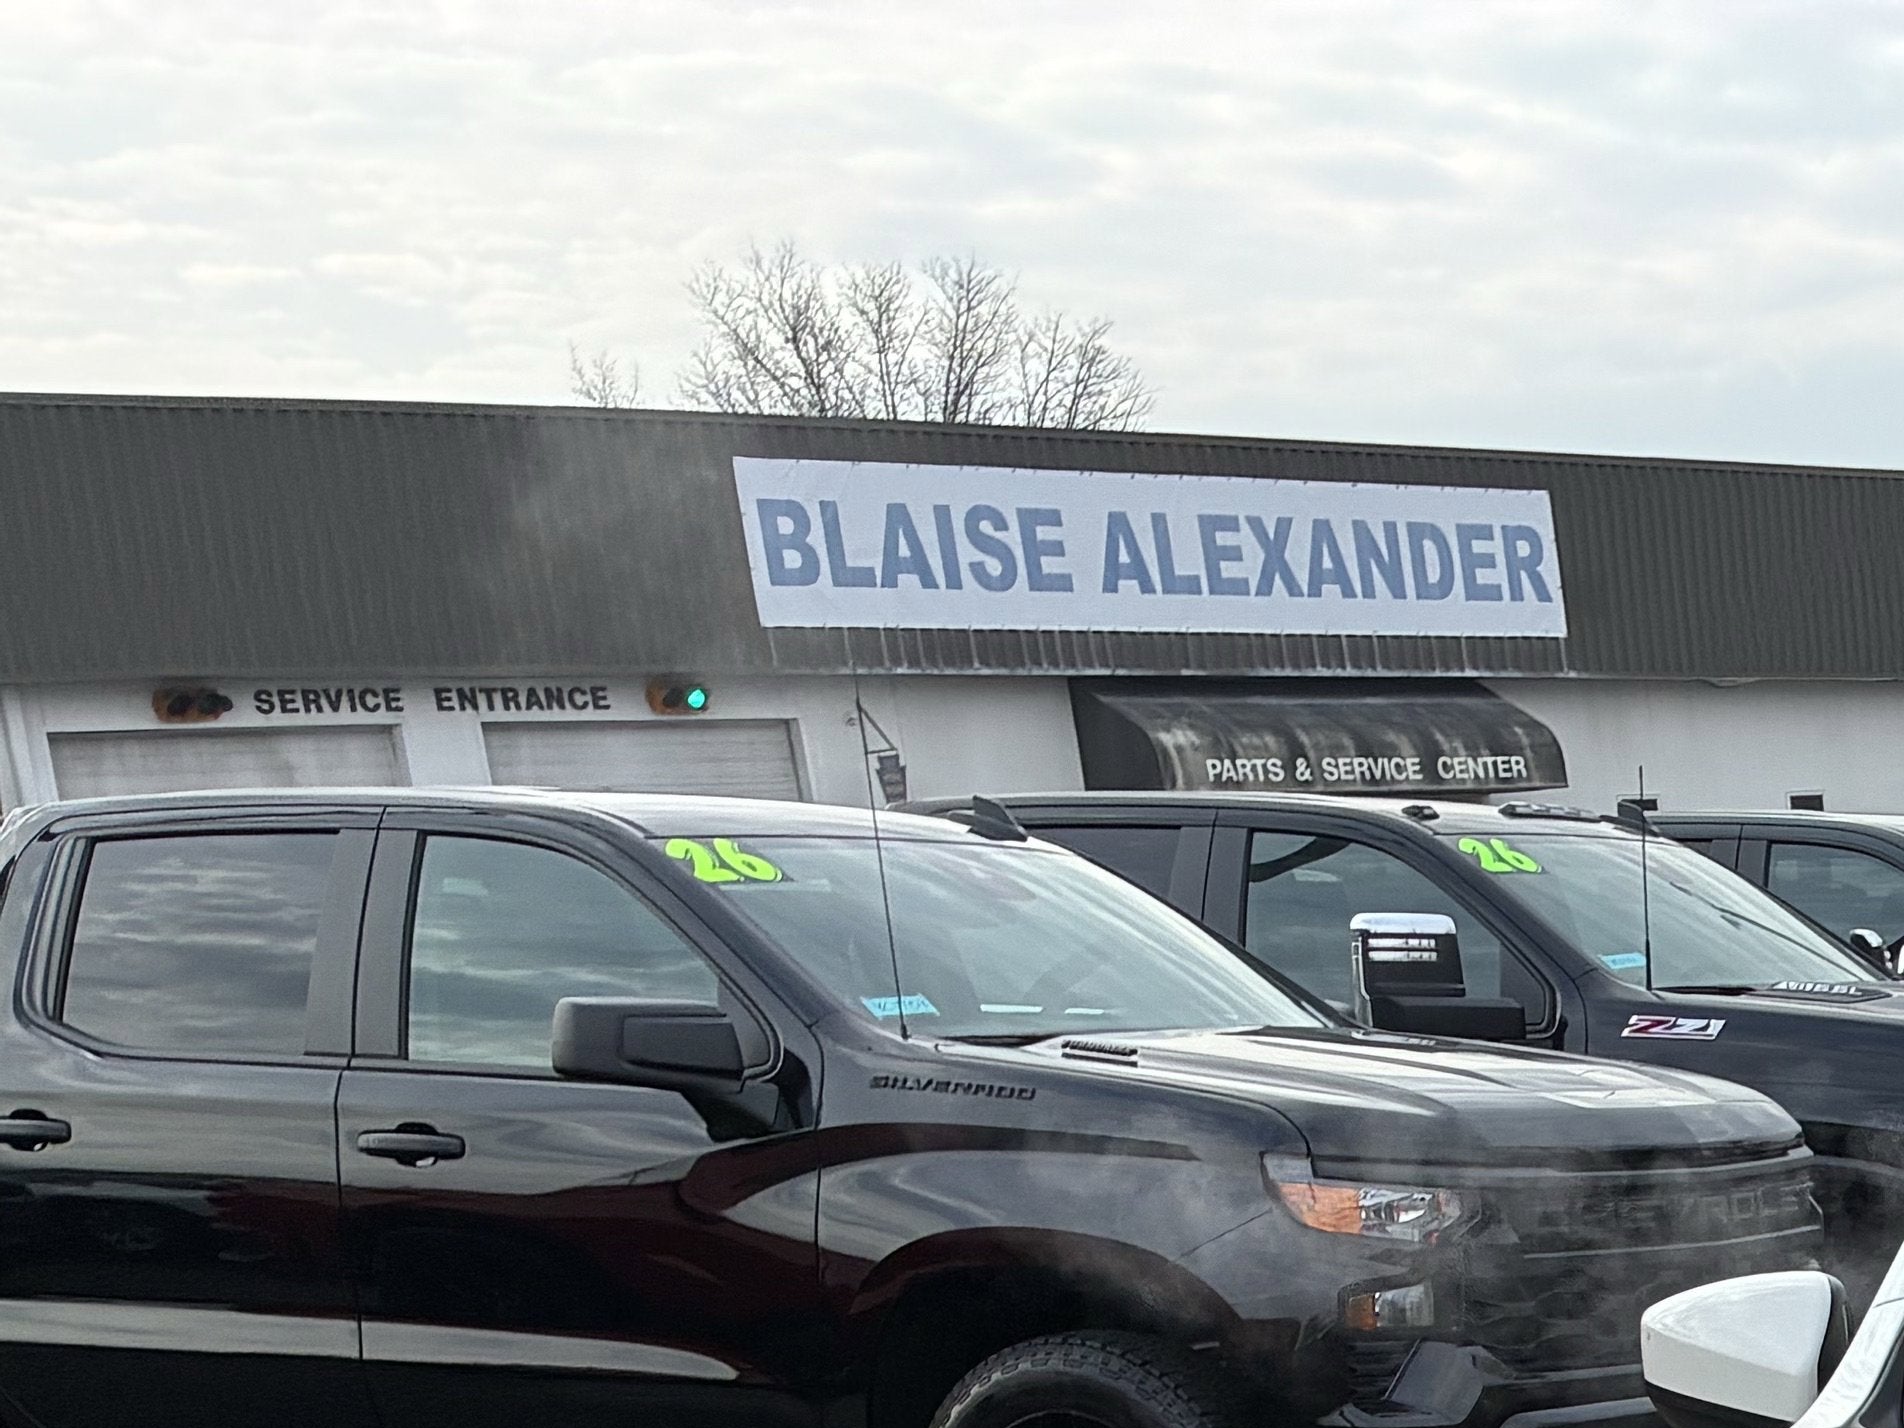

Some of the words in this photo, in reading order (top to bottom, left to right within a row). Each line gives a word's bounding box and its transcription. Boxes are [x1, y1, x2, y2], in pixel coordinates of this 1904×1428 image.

[756, 498, 1074, 593] BLAISE
[1102, 511, 1553, 603] ALEXANDER
[253, 688, 404, 715] SERVICE
[433, 686, 612, 712] ENTRANCE
[1206, 758, 1285, 782] PARTS
[1295, 758, 1312, 781] &
[1321, 757, 1423, 781] SERVICE
[1437, 755, 1528, 779] CENTER
[665, 838, 783, 882] 26
[1459, 838, 1542, 873] 26
[869, 1074, 1036, 1101] SILVERADO
